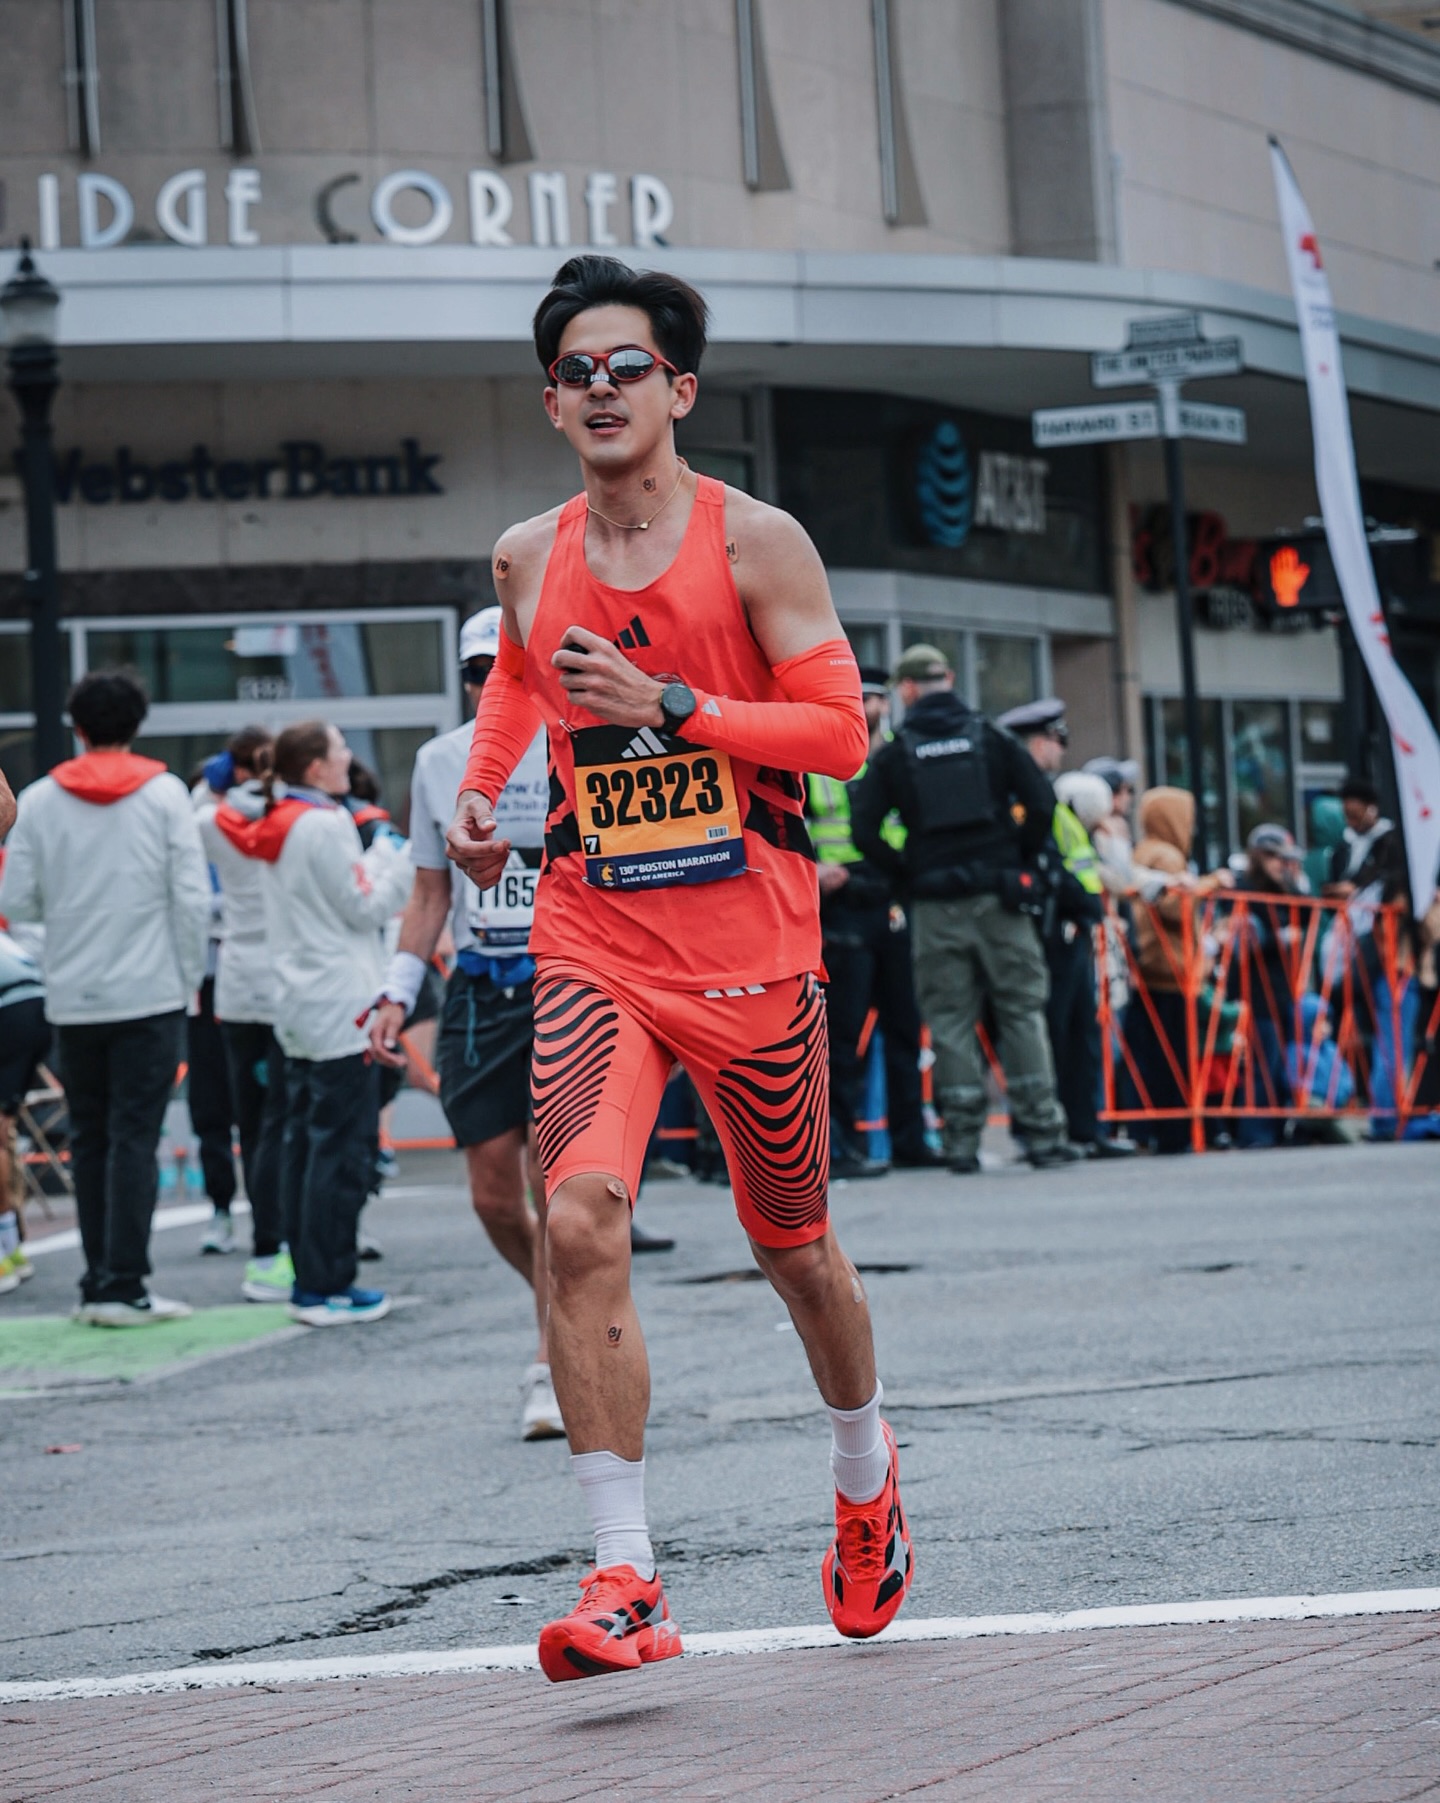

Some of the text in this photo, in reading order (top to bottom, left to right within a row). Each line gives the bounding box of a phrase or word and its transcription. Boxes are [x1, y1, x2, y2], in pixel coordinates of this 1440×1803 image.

[0, 168, 674, 248] IDGE CORNER
[586, 757, 723, 829] 32323
[585, 837, 598, 853] 7
[639, 860, 677, 873] BOSTON
[678, 851, 730, 868] MARATHON
[622, 876, 640, 884] BANK
[652, 870, 685, 880] AMERICA
